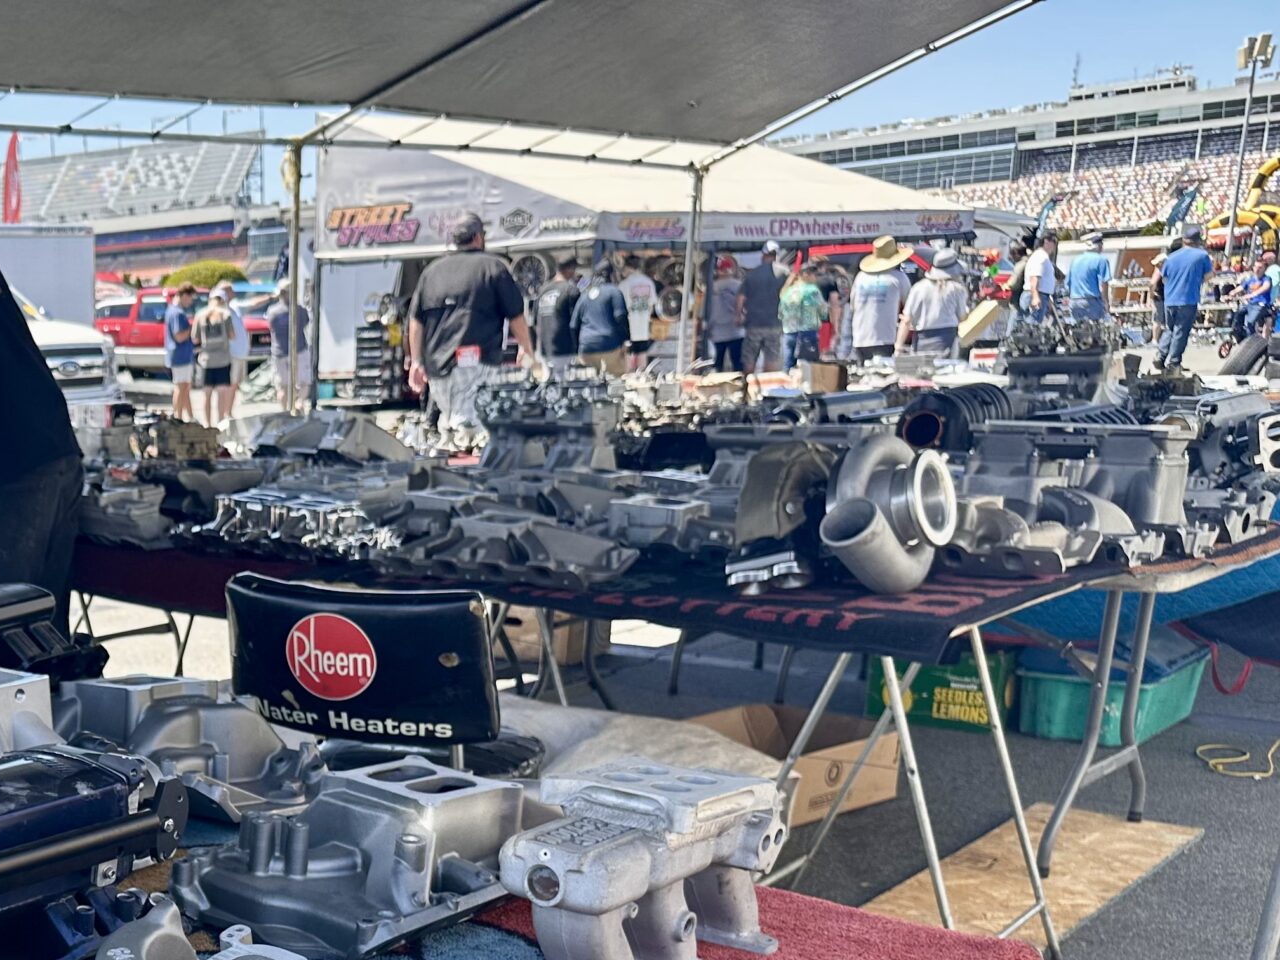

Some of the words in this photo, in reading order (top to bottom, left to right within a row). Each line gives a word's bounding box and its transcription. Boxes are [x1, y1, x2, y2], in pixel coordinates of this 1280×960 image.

[326, 203, 413, 230] STREET
[733, 217, 880, 237] www.CPPwheels.com
[337, 219, 420, 246] STYLES
[292, 616, 372, 683] Rheem
[933, 687, 987, 707] SEEDLES
[328, 710, 453, 738] Heaters
[931, 702, 989, 725] LEMONS
